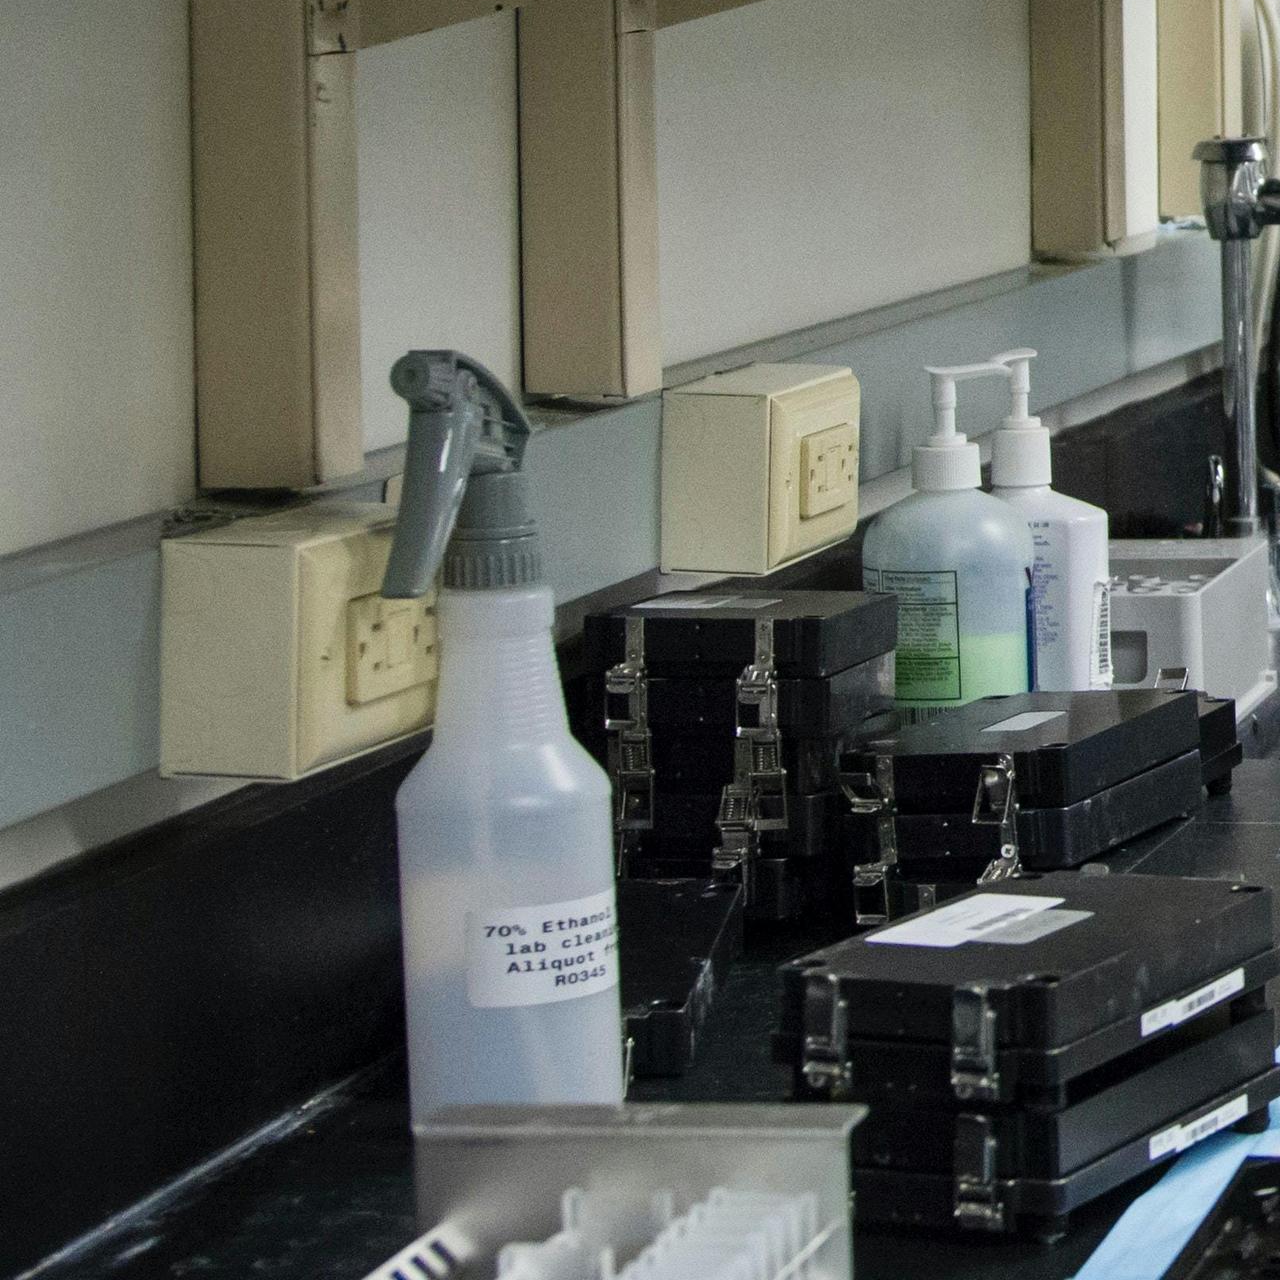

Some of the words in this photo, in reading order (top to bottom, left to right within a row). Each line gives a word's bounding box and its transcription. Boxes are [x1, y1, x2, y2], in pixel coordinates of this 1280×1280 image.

[484, 924, 527, 938] 70%
[542, 906, 612, 934] Ethanol
[506, 941, 546, 955] lab
[507, 951, 595, 974] Aliquot
